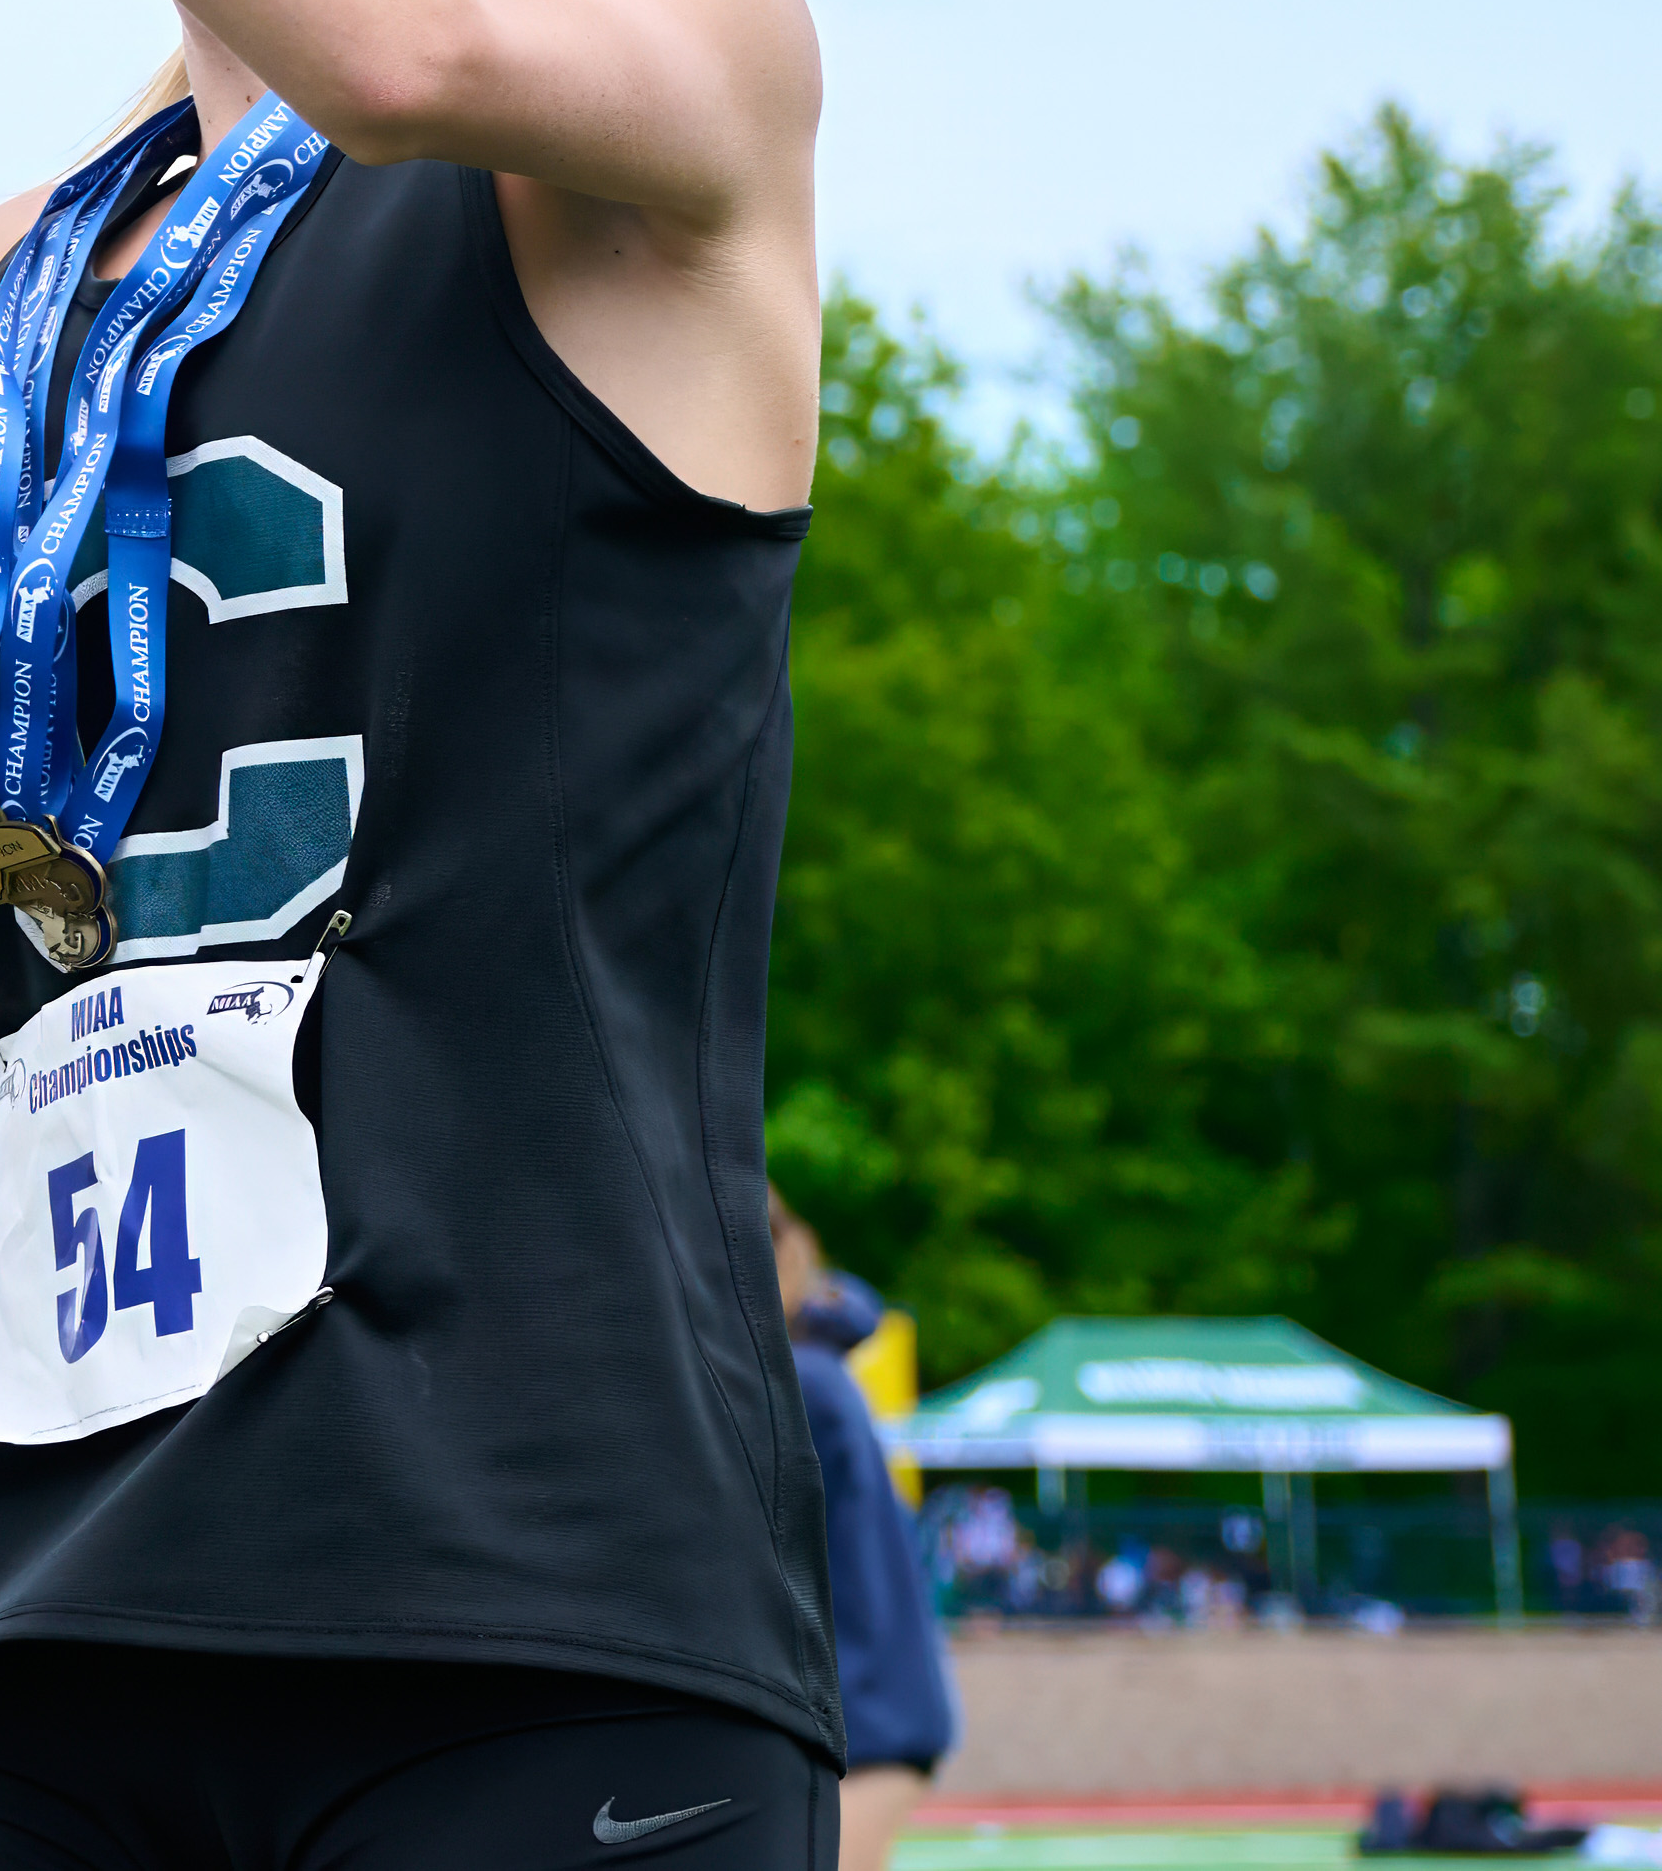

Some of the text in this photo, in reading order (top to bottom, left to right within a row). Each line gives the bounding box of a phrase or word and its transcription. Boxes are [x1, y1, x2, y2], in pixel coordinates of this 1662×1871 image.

[218, 101, 292, 185] AMPION
[86, 267, 171, 384] CHAMPION
[186, 228, 263, 334] CHAMPION
[41, 433, 107, 555] CHAMPION
[130, 582, 150, 723] CHAMPION
[5, 658, 33, 796] CHAMPION
[29, 1024, 197, 1115] Championships
[71, 986, 125, 1042] MIAA
[47, 1128, 202, 1364] 54
